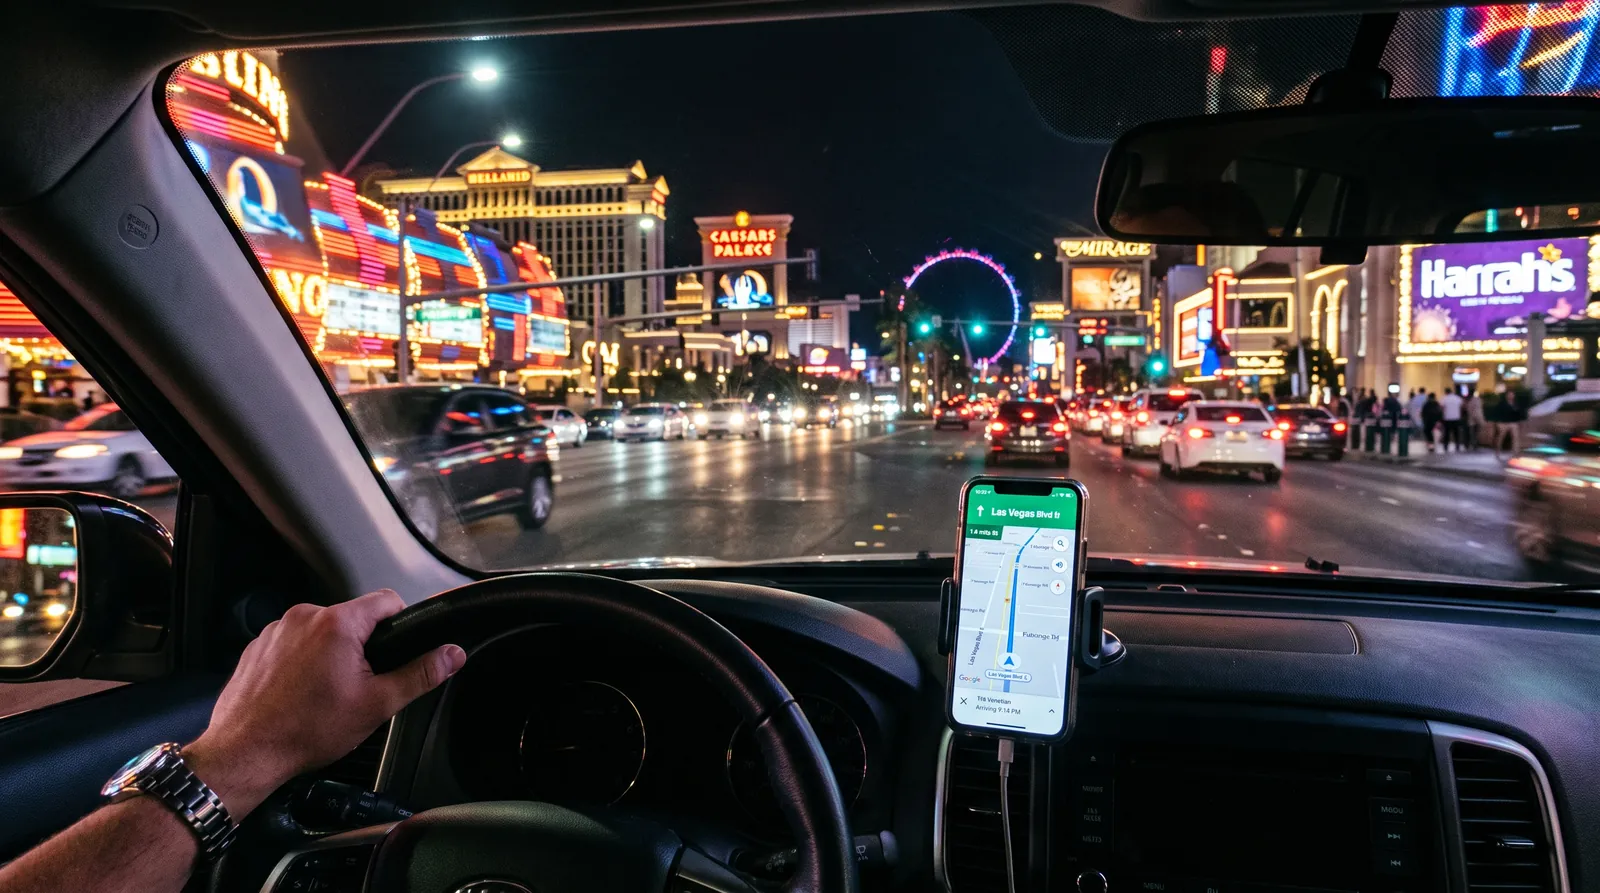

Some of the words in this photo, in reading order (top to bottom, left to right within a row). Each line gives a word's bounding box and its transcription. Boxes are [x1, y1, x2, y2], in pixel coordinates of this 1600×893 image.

[710, 229, 777, 244] CAESARS
[714, 243, 773, 258] PALACE
[991, 507, 1006, 516] Las
[1008, 508, 1035, 519] Vegas
[1036, 510, 1052, 518] Blvd
[975, 704, 997, 713] Arriving
